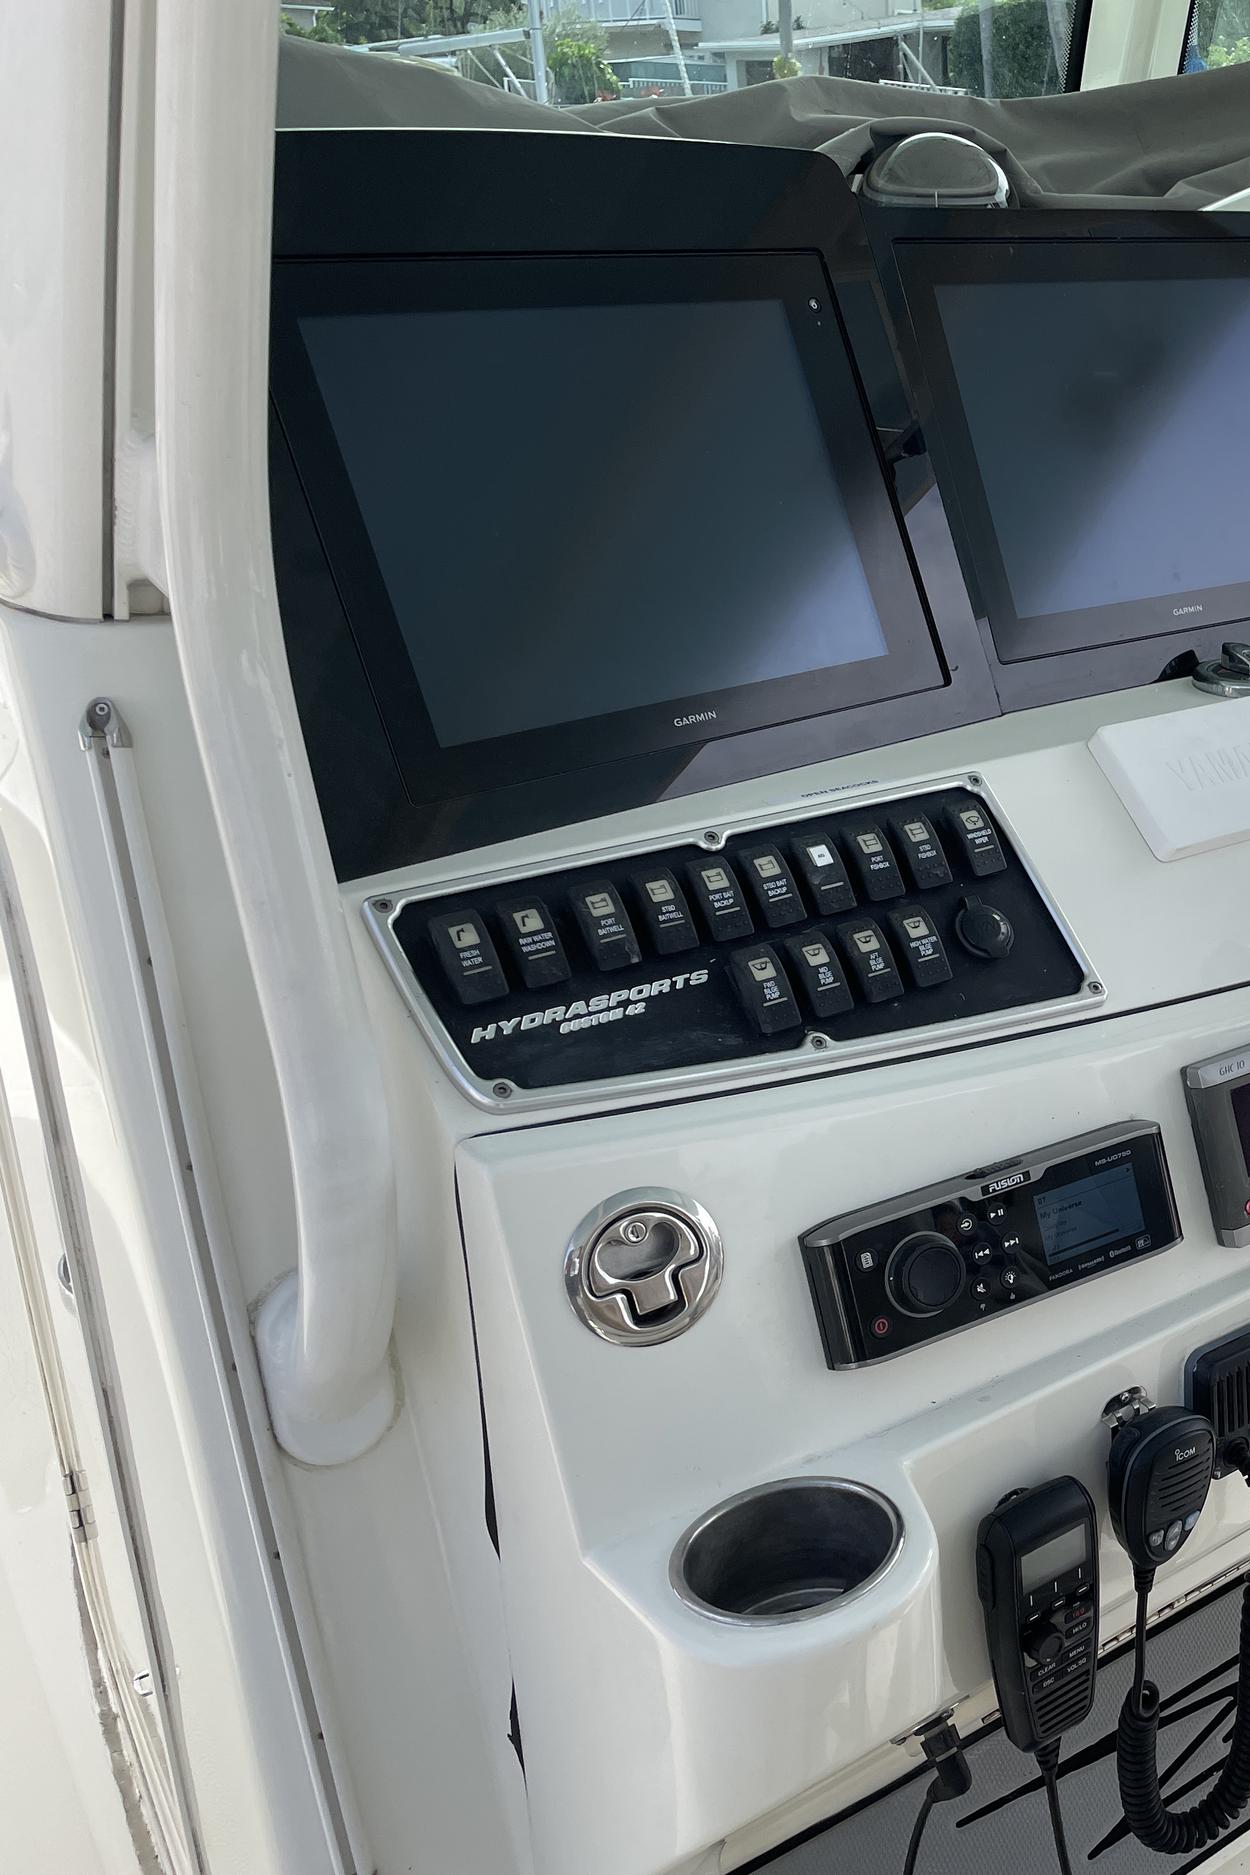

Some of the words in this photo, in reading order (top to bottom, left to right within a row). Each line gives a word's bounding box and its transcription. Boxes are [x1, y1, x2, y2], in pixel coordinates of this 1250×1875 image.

[1173, 604, 1202, 616] GARMIN
[674, 710, 716, 726] GARMIN
[708, 892, 722, 901] PORT
[722, 890, 734, 898] BAIT
[768, 886, 788, 896] BACKUP
[714, 898, 734, 908] BACKUP
[600, 918, 615, 926] PORT
[598, 924, 624, 936] BAITWELL
[533, 932, 554, 941] WATER
[522, 940, 556, 952] WASHDOWN
[460, 949, 480, 959] FRESH
[921, 948, 934, 956] PUMP
[462, 956, 484, 967] WATER
[872, 963, 884, 972] PUMP
[820, 976, 834, 984] PUMP
[766, 992, 780, 1000] PUMP
[470, 970, 708, 1044] HYDRASPORTS
[560, 1007, 624, 1034] CUSTOM
[626, 1002, 646, 1016] 42
[1219, 1064, 1234, 1076] GHC
[1237, 1060, 1245, 1070] 10
[989, 1174, 1024, 1192] FUSION
[1070, 1646, 1084, 1658] MENU
[1038, 1663, 1056, 1676] CLEAR
[1043, 1677, 1054, 1687] DSC
